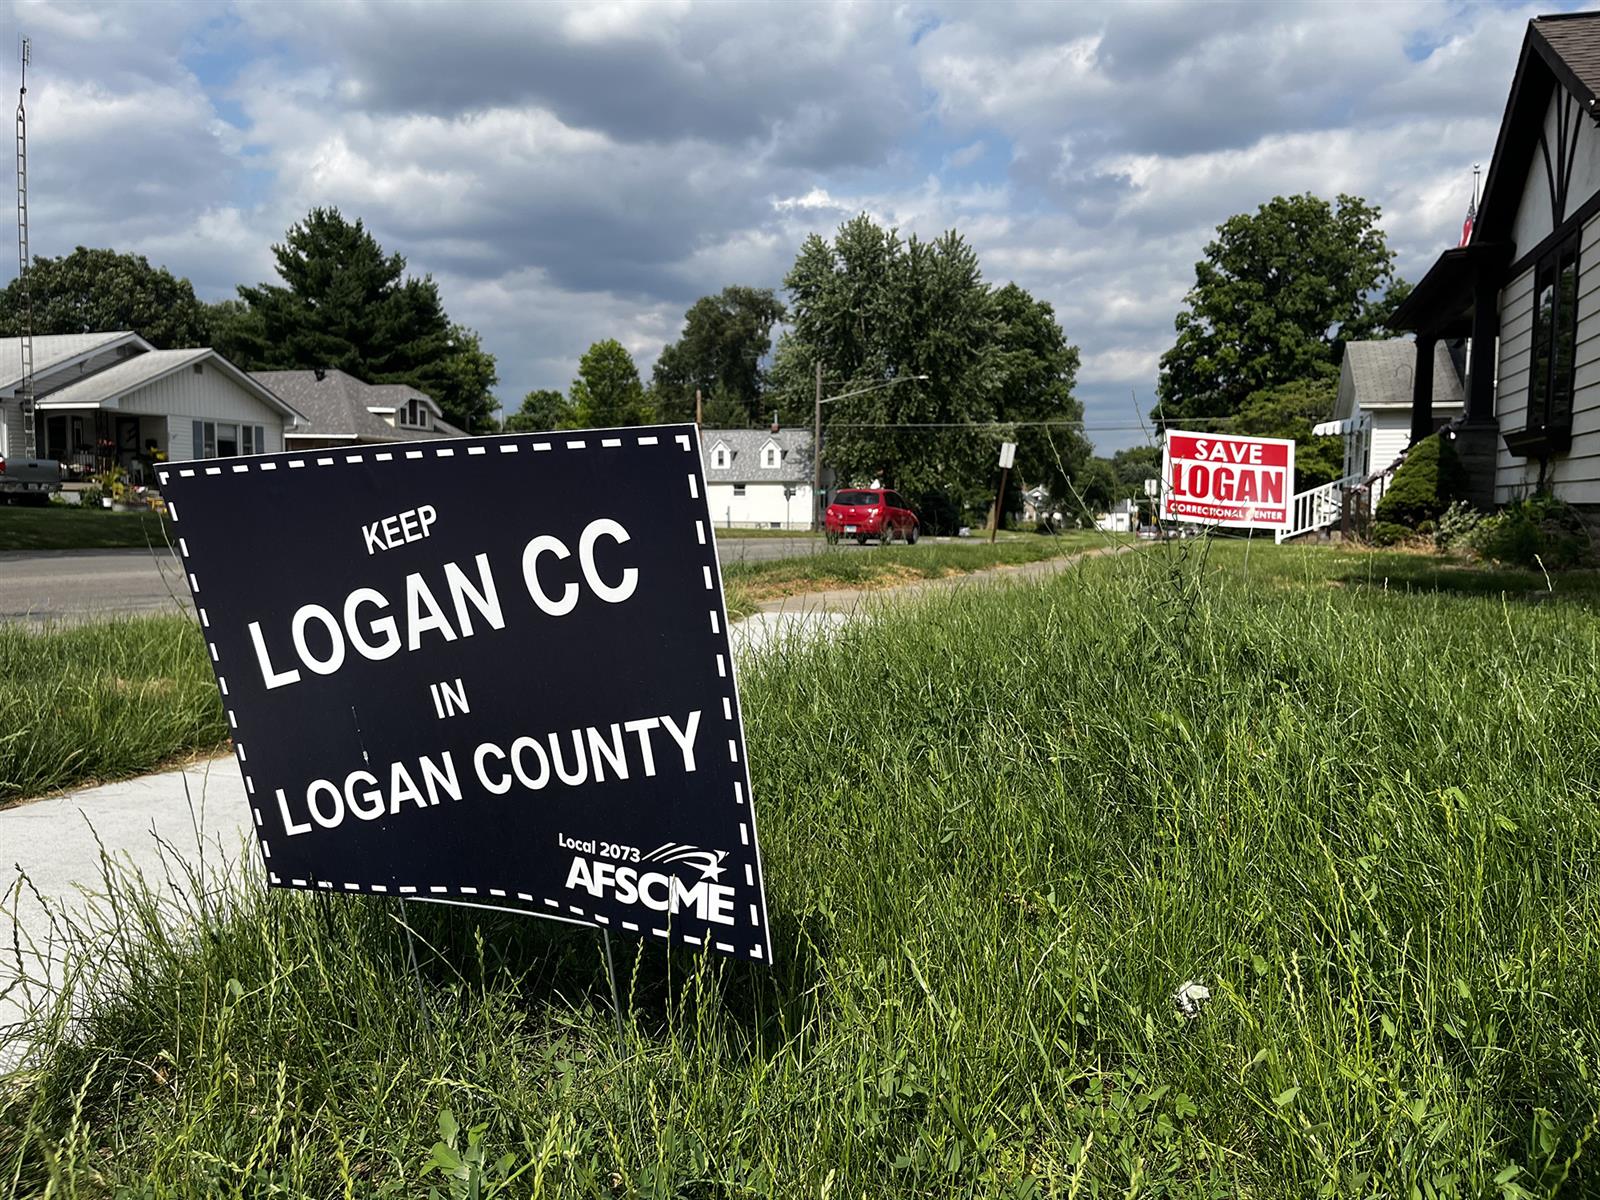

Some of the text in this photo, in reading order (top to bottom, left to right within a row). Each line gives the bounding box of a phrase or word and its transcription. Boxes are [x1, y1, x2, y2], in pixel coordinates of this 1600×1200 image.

[1195, 440, 1262, 464] SAVE
[1173, 463, 1283, 503] LOGAN
[362, 504, 437, 554] KEEP
[1170, 503, 1243, 518] CORRECTIONAL
[249, 518, 639, 690] LOGAN CC
[430, 678, 470, 719] IN
[276, 710, 701, 836] LOGAN COUNTY
[558, 832, 641, 863] Local 2073
[565, 856, 735, 926] AFSCME
